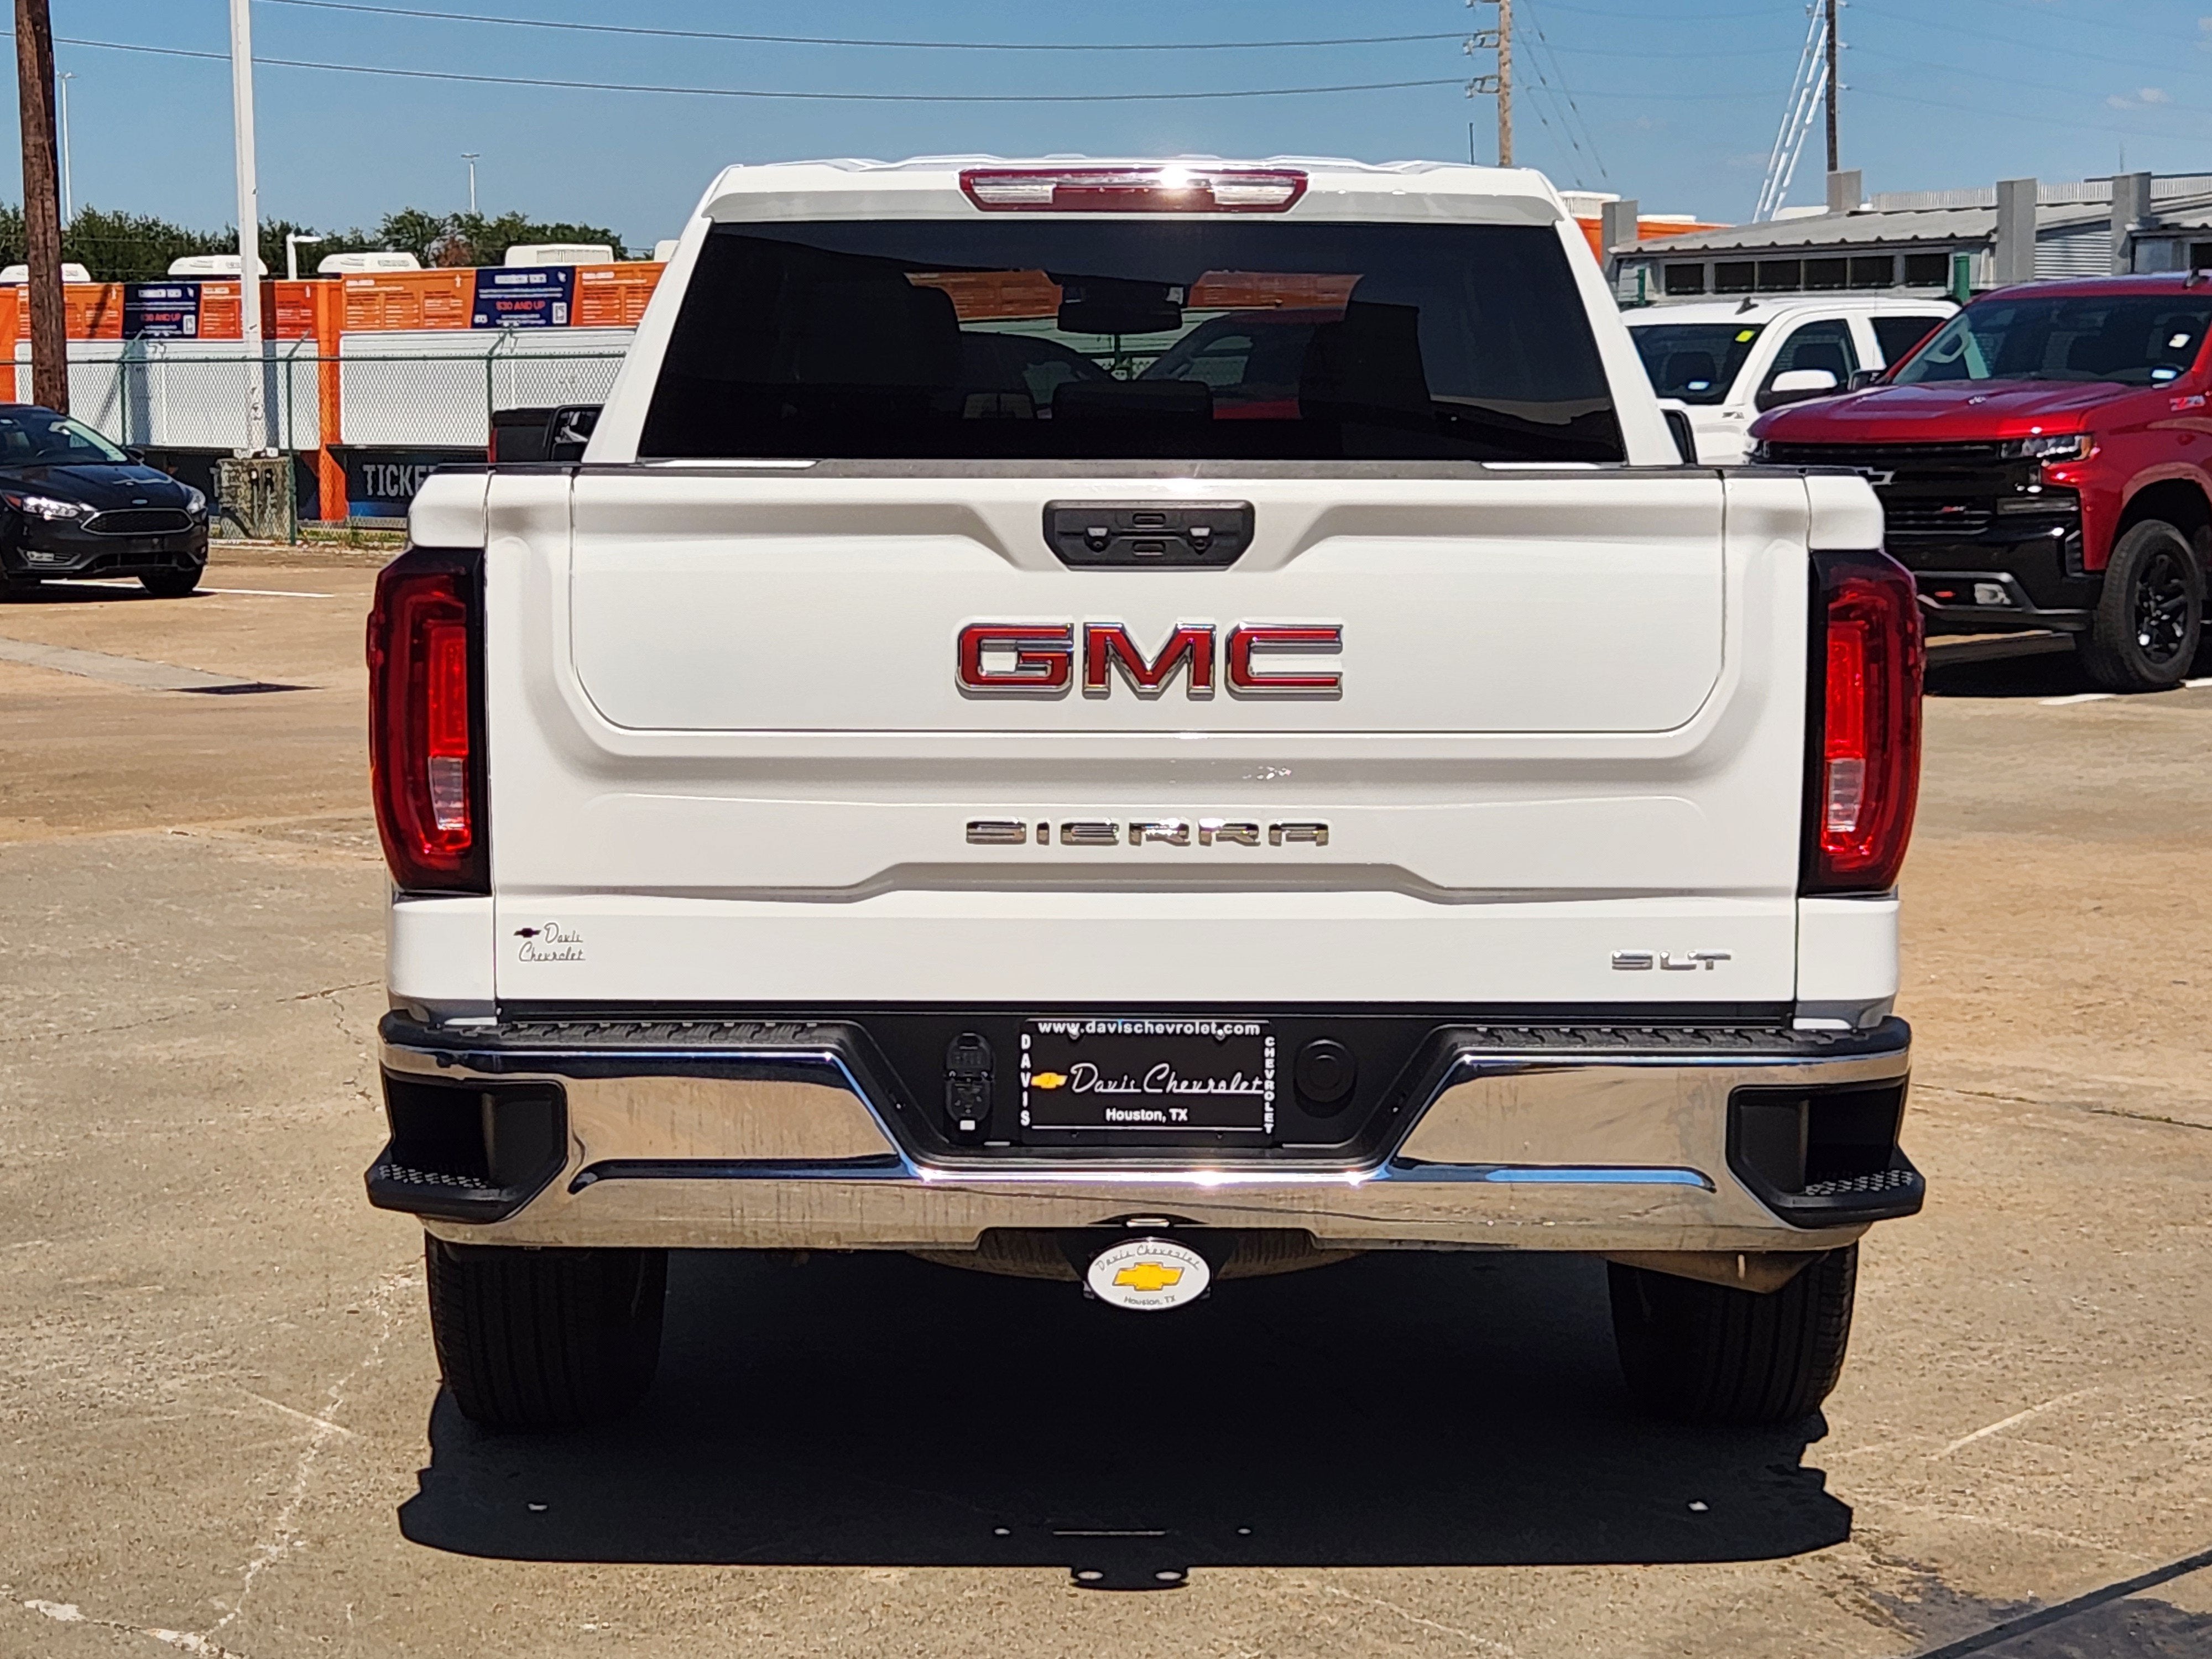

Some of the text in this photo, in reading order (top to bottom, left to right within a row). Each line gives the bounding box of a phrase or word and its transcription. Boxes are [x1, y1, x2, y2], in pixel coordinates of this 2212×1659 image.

[362, 464, 438, 497] TICKE
[957, 621, 1344, 699] GMC
[966, 818, 1329, 846] SIERRA
[544, 922, 583, 943] Davis
[519, 941, 586, 962] Chevrolet
[1611, 951, 1731, 971] SLT
[1037, 1020, 1261, 1036] www.davischevrolet.com
[1020, 1033, 1031, 1126] DAVIS
[1070, 1062, 1264, 1094] Davis Chevrolet
[1264, 1036, 1276, 1134] CHEVROLET
[1105, 1108, 1188, 1123] Houston, TX
